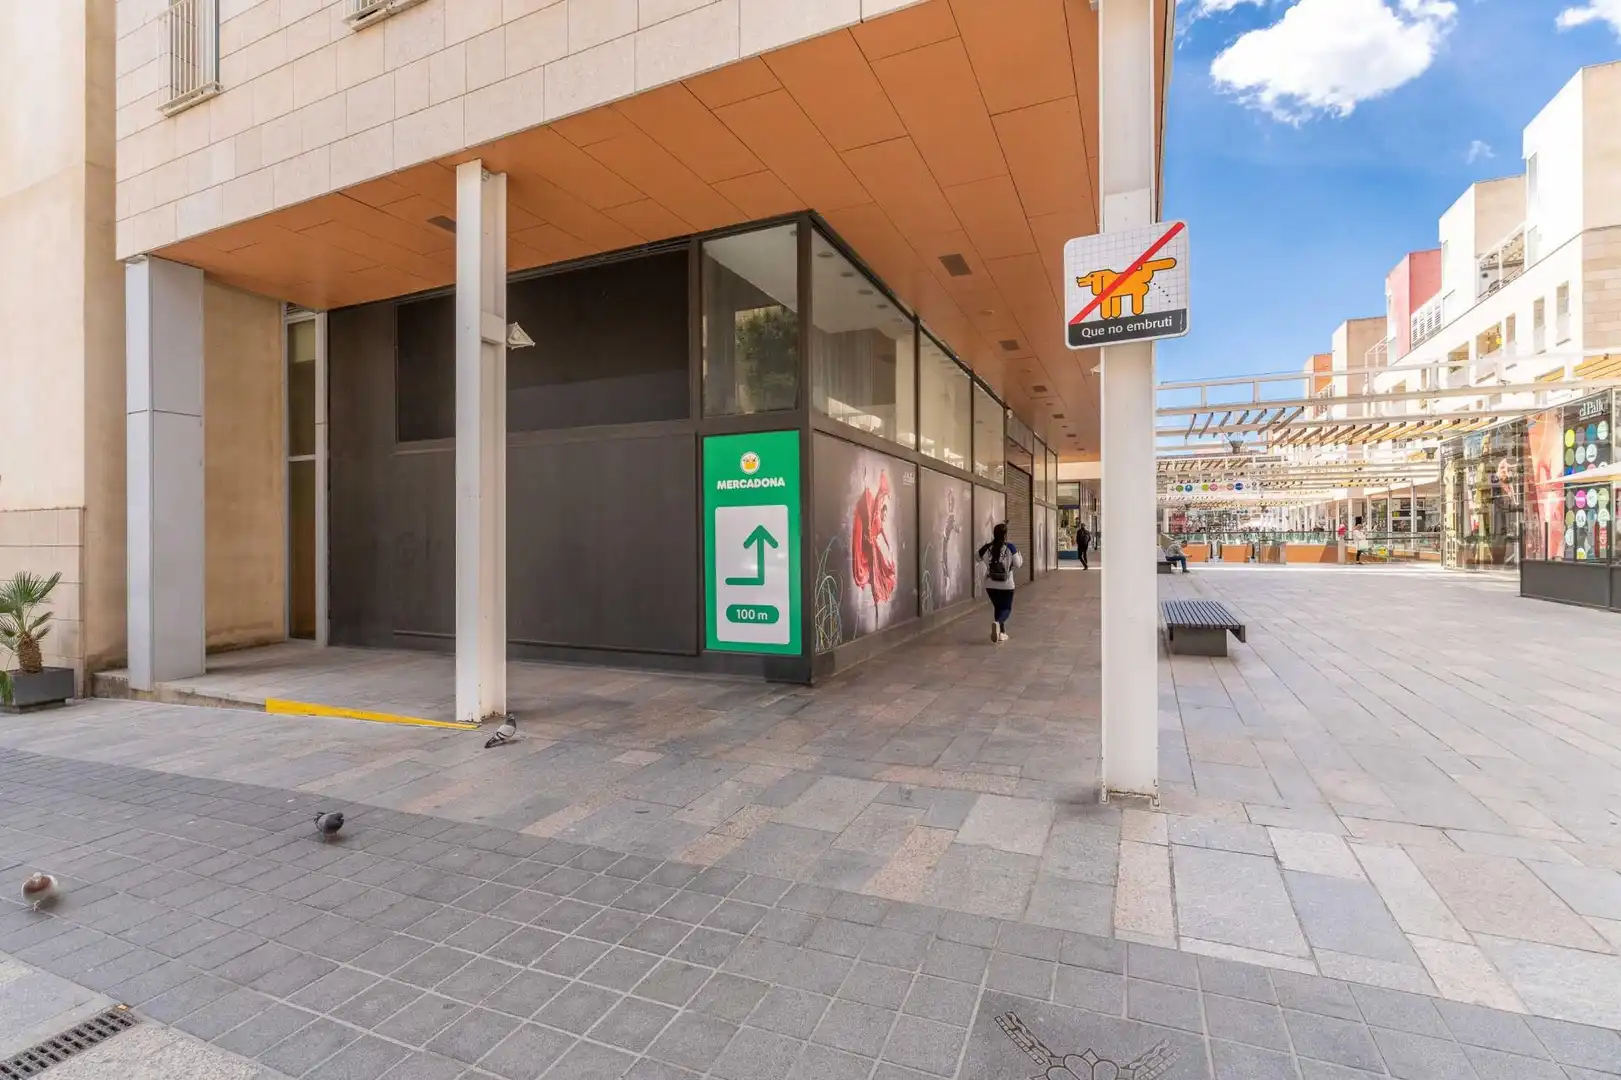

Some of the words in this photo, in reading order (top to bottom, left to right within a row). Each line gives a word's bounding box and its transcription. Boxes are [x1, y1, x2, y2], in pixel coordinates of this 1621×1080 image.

[1081, 327, 1105, 338] Que
[1108, 324, 1123, 334] no
[1126, 315, 1173, 332] embruti
[717, 477, 786, 490] MERCADONA
[736, 609, 755, 620] 100
[757, 611, 768, 620] m
